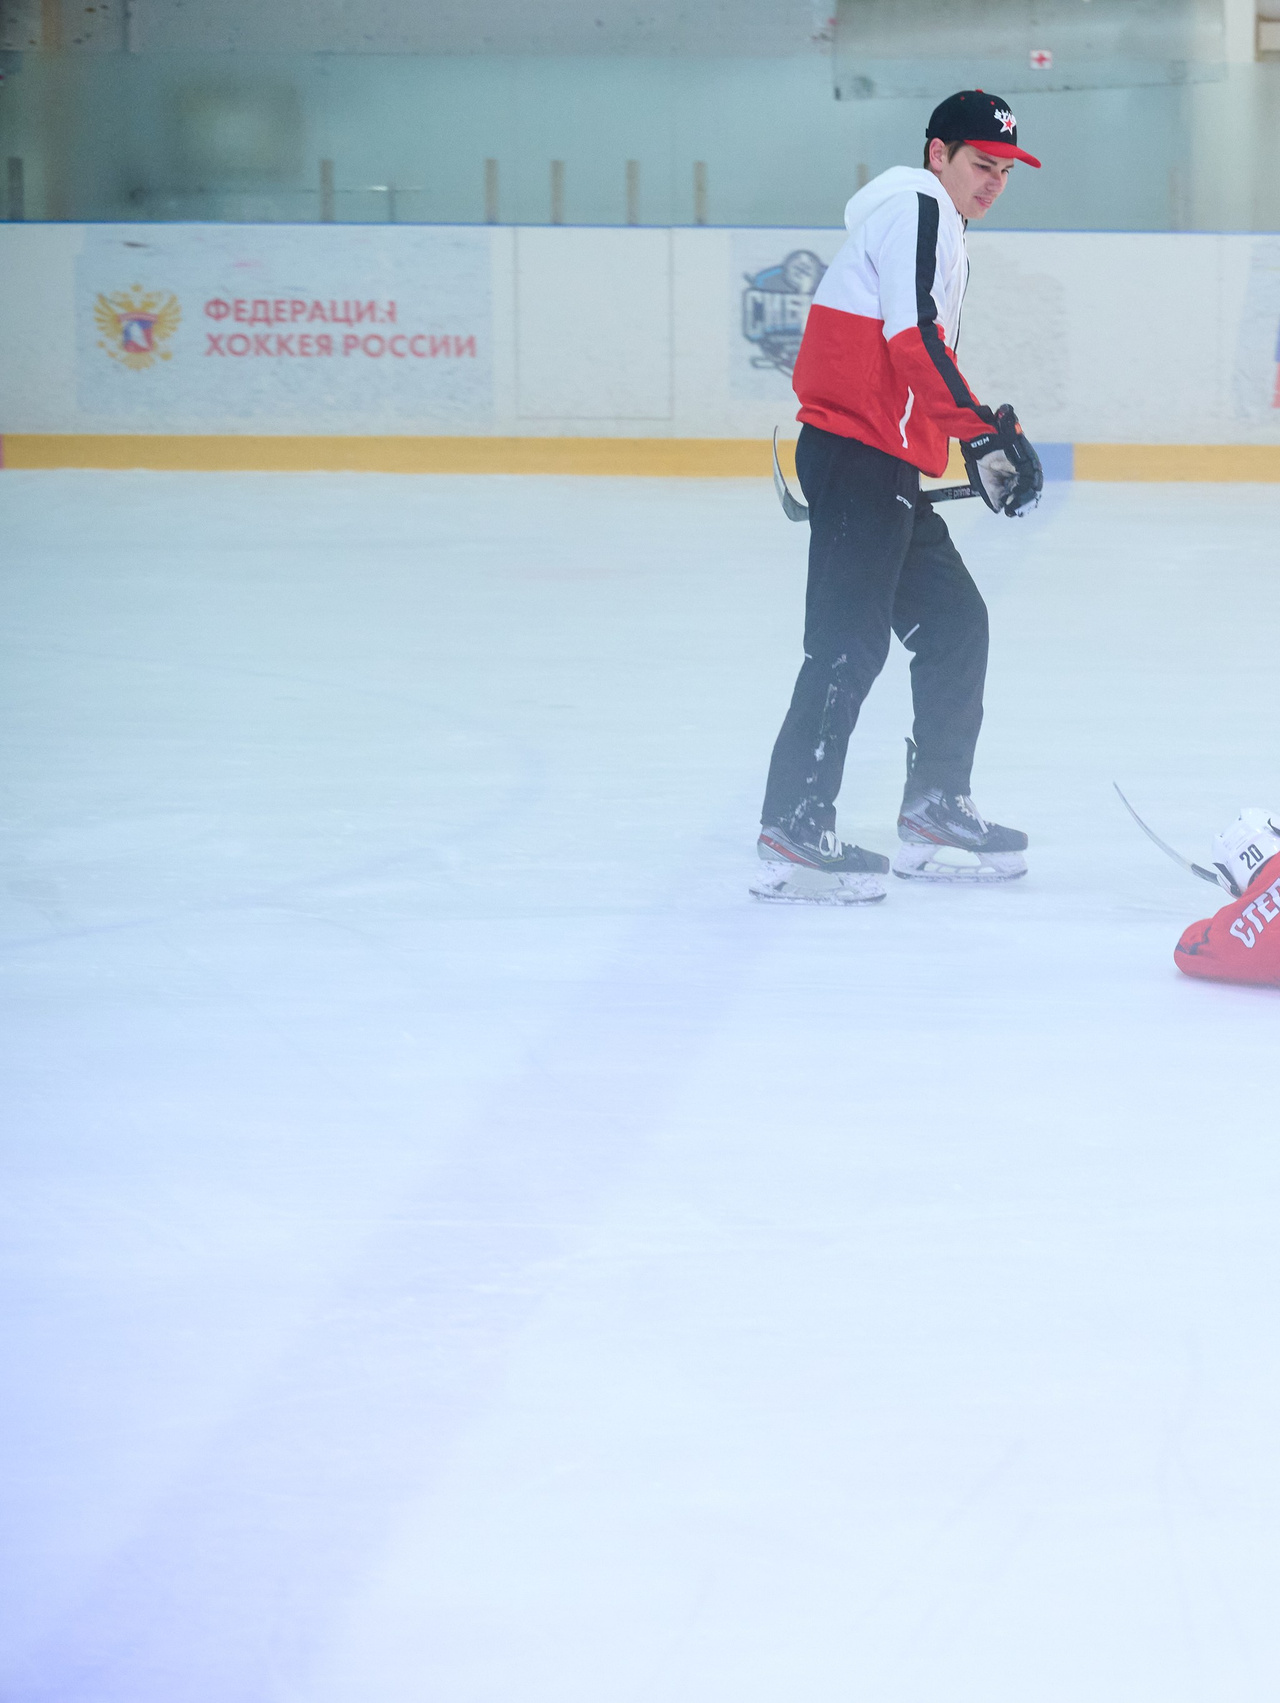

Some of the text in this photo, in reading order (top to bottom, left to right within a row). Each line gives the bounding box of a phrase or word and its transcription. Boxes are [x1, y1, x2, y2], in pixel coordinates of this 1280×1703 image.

[204, 333, 478, 358] ХОККЕЯ РОССИИ
[1239, 843, 1264, 871] 20
